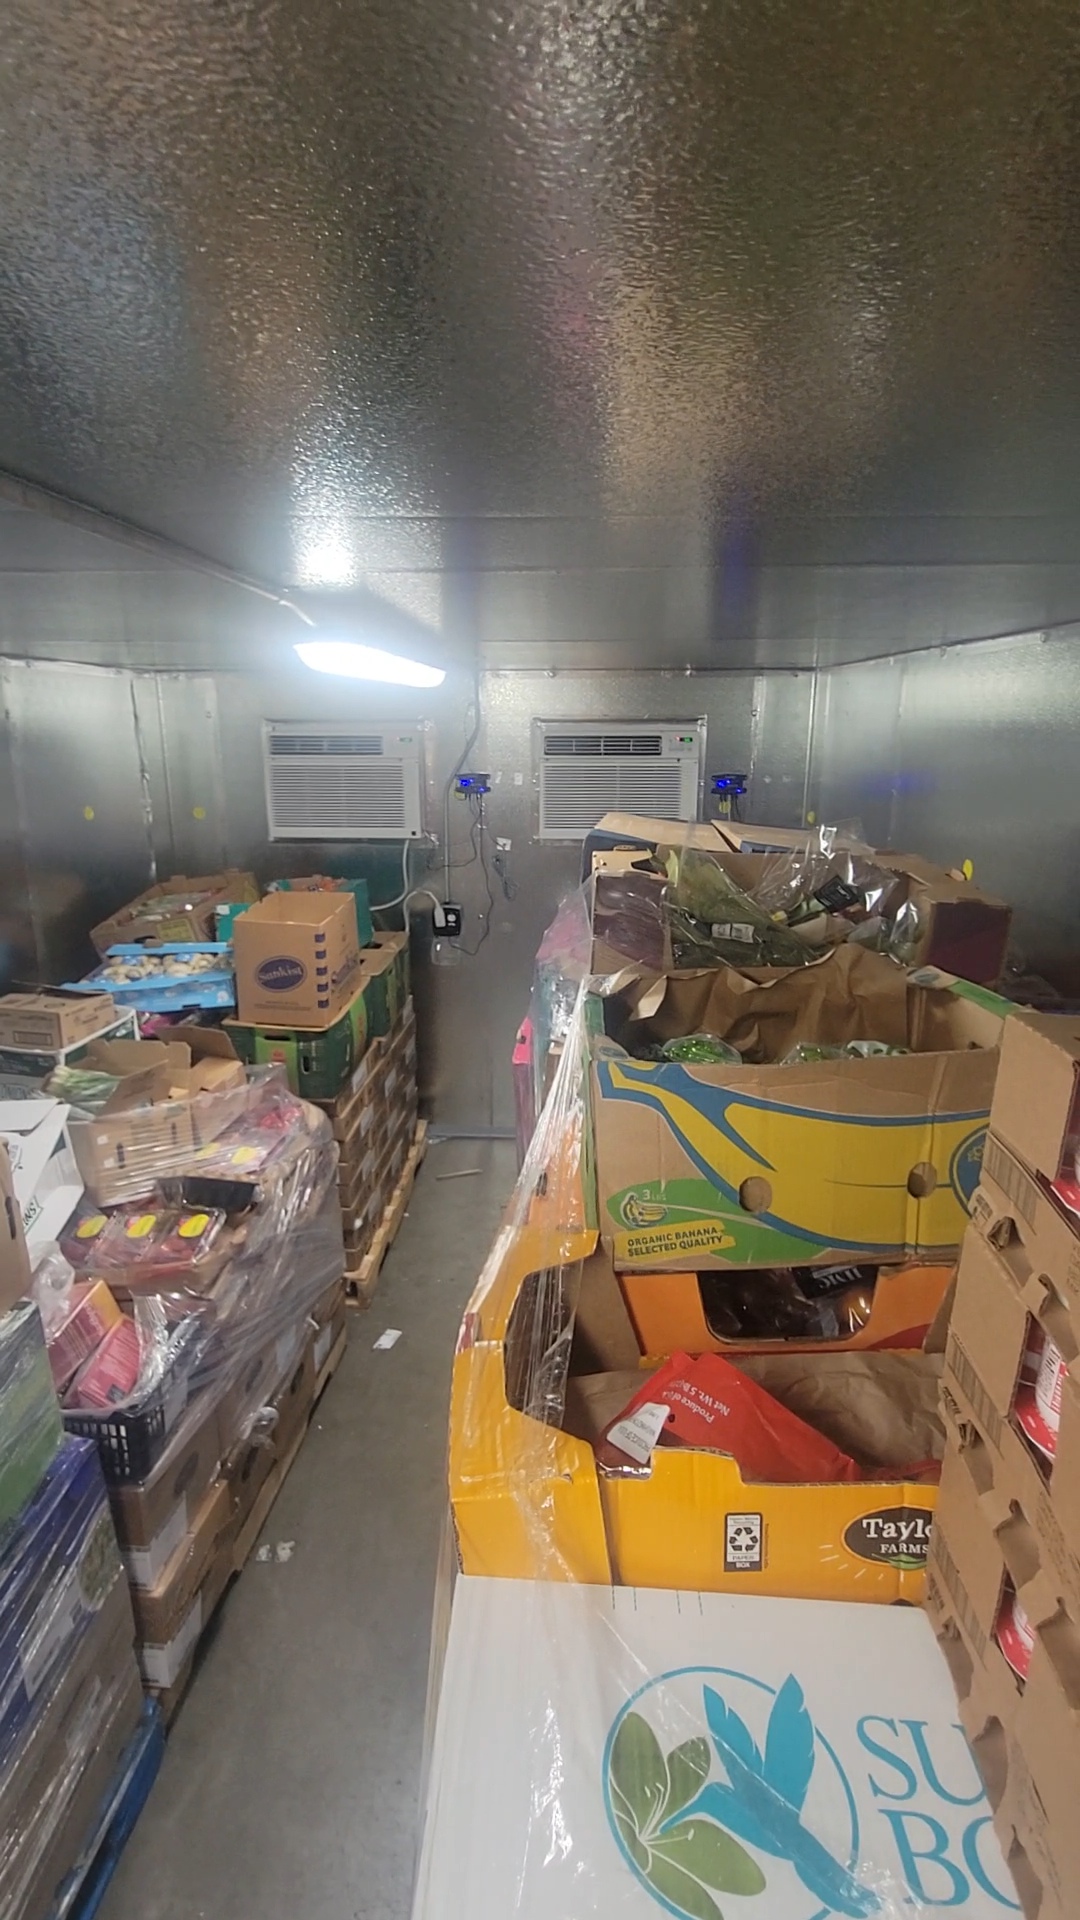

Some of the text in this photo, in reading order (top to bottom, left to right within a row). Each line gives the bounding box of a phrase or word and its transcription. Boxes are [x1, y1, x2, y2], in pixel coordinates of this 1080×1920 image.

[642, 1189, 651, 1200] 3
[627, 1227, 718, 1247] ORGANIC BANANA
[627, 1235, 723, 1257] SELECTED QUALITY
[690, 1387, 698, 1396] 5
[698, 1393, 714, 1407] Wt.
[680, 1397, 715, 1423] Produce
[713, 1402, 730, 1416] Net
[880, 1543, 929, 1554] FARMS
[856, 1715, 987, 1806] SU
